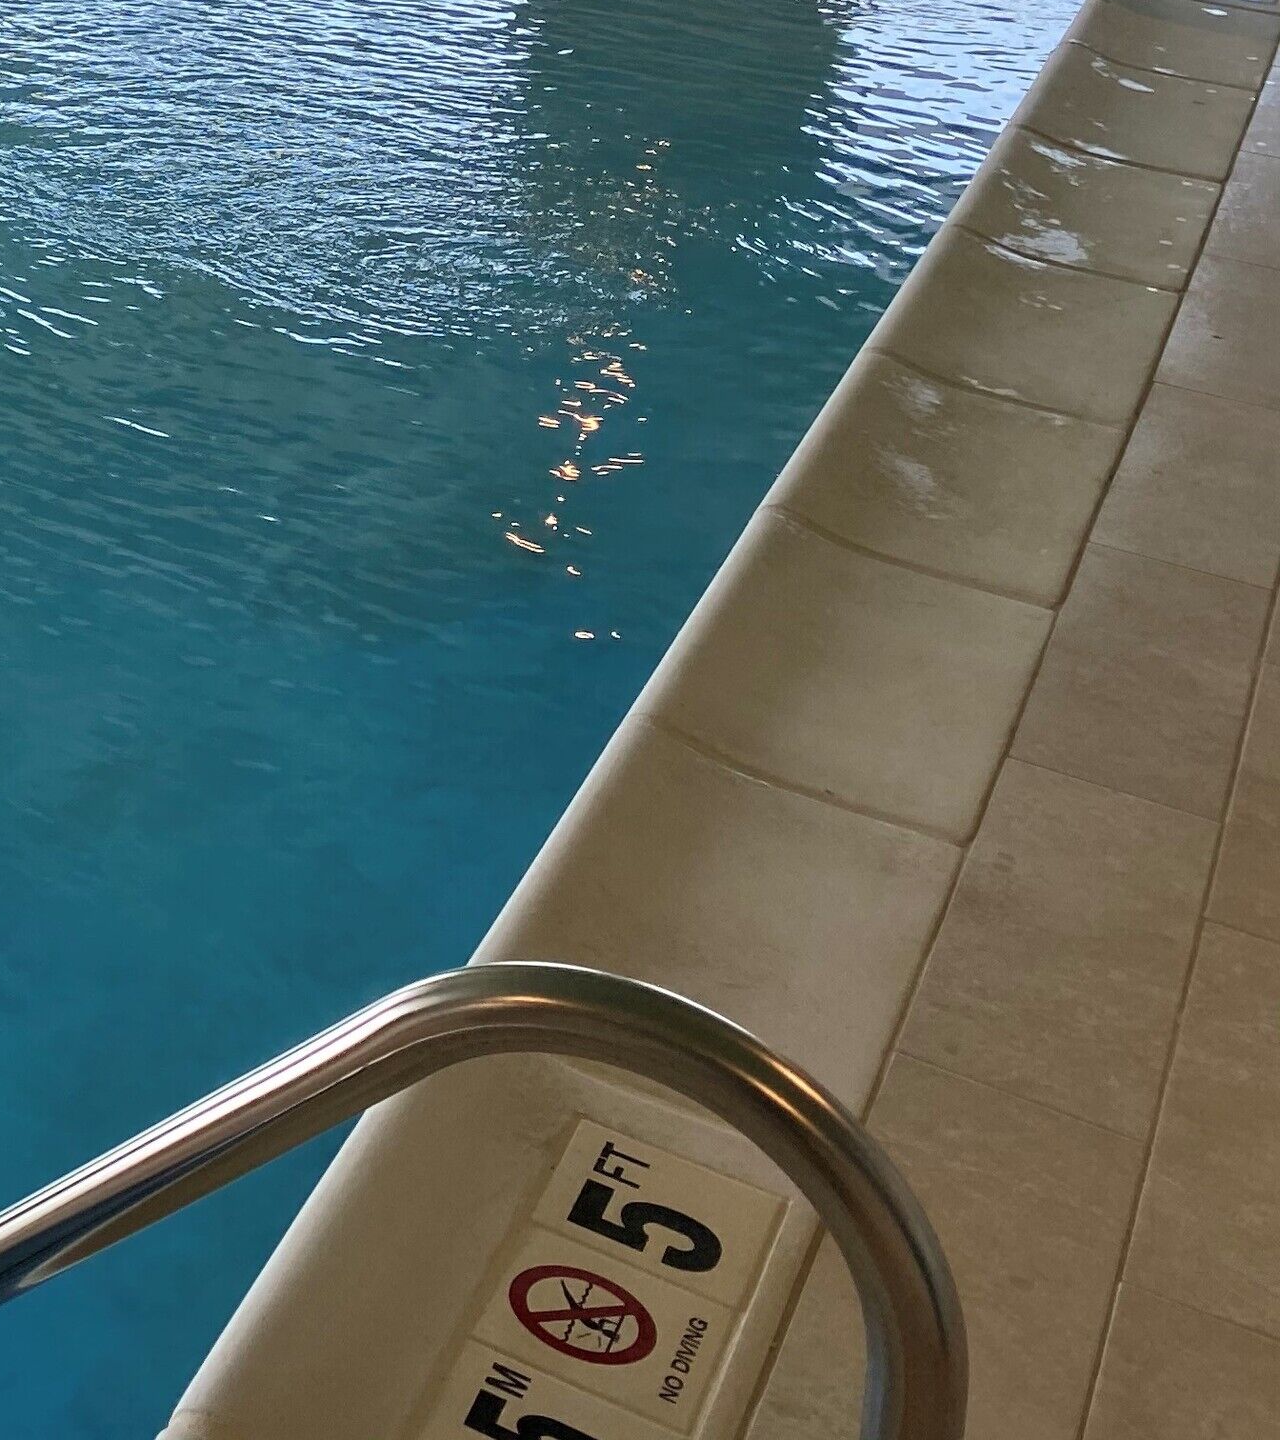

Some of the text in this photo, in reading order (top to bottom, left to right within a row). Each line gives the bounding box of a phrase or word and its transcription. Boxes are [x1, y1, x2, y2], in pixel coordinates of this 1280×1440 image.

[566, 1141, 722, 1273] 5 FT
[658, 1317, 708, 1405] NO DIVING
